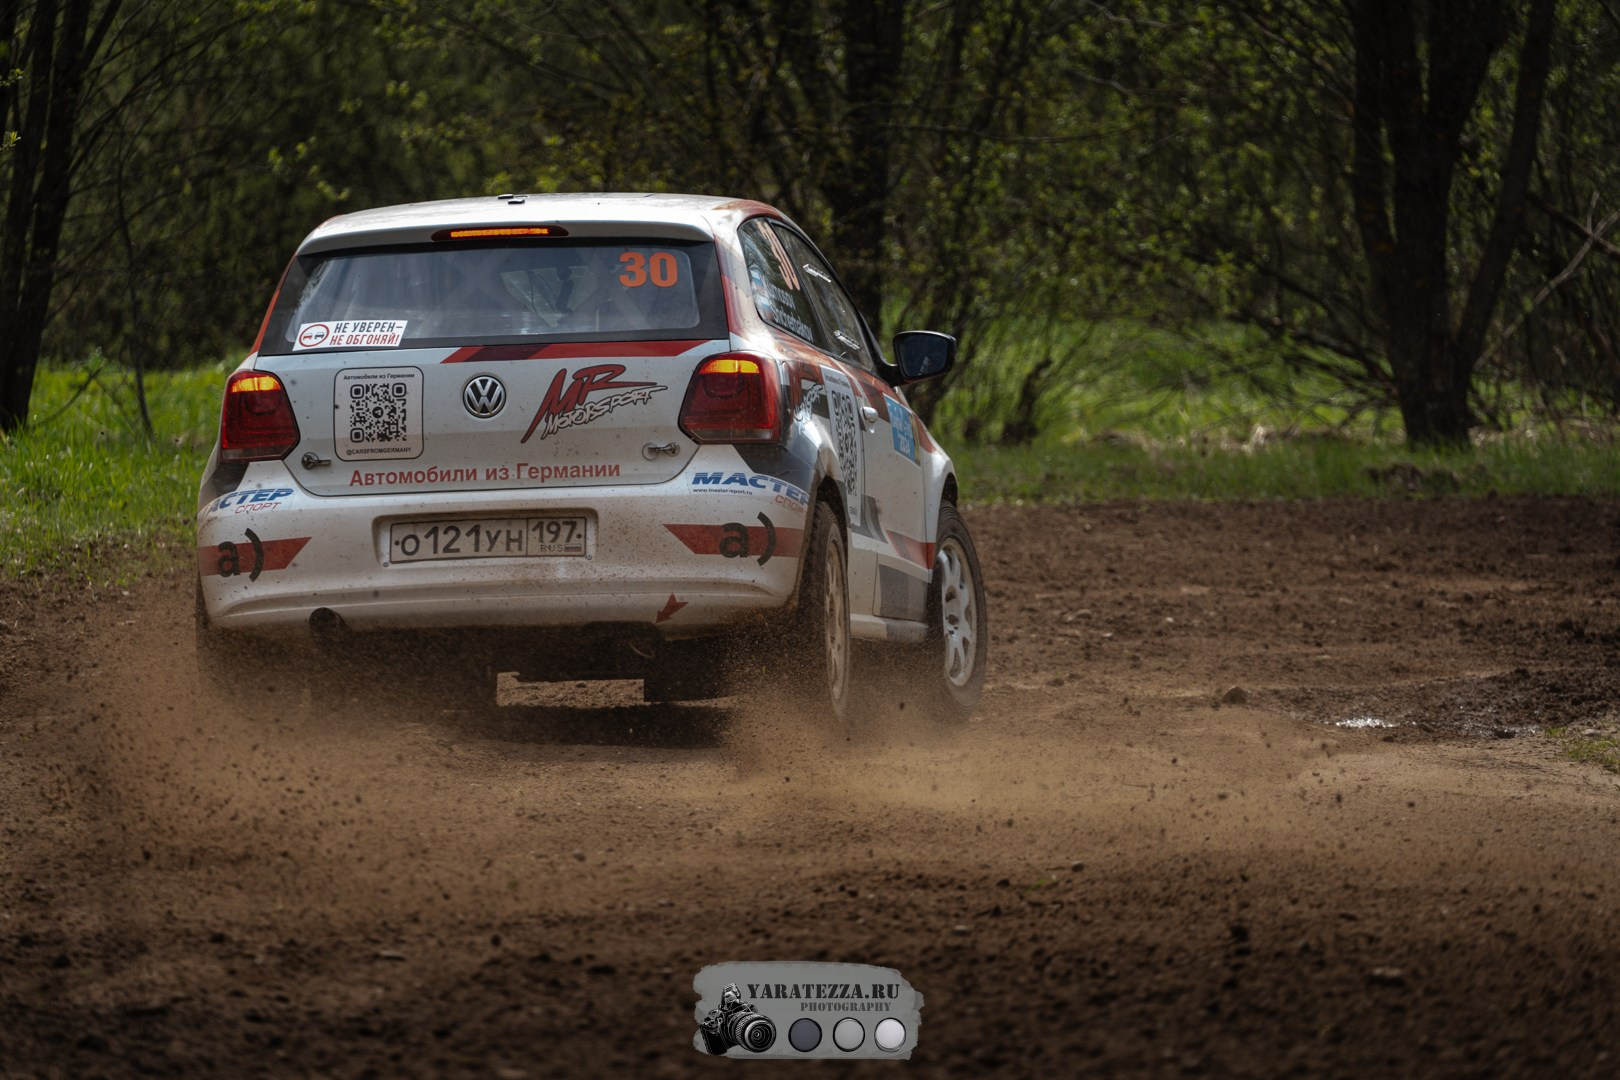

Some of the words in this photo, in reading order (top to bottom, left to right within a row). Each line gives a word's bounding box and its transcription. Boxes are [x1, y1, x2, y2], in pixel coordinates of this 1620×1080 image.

[619, 251, 678, 288] 30
[333, 322, 350, 334] НЕ
[329, 335, 342, 346] НЕ
[345, 332, 400, 345] ОБГОНЯЙ!
[346, 447, 412, 456] @CARSFROMGERMANY
[350, 465, 478, 487] Автомобили
[485, 467, 510, 481] из
[516, 462, 621, 483] Германии
[692, 487, 753, 496] www.master-sport.ru
[235, 502, 282, 515] СПОРТ
[540, 544, 563, 552] RUS
